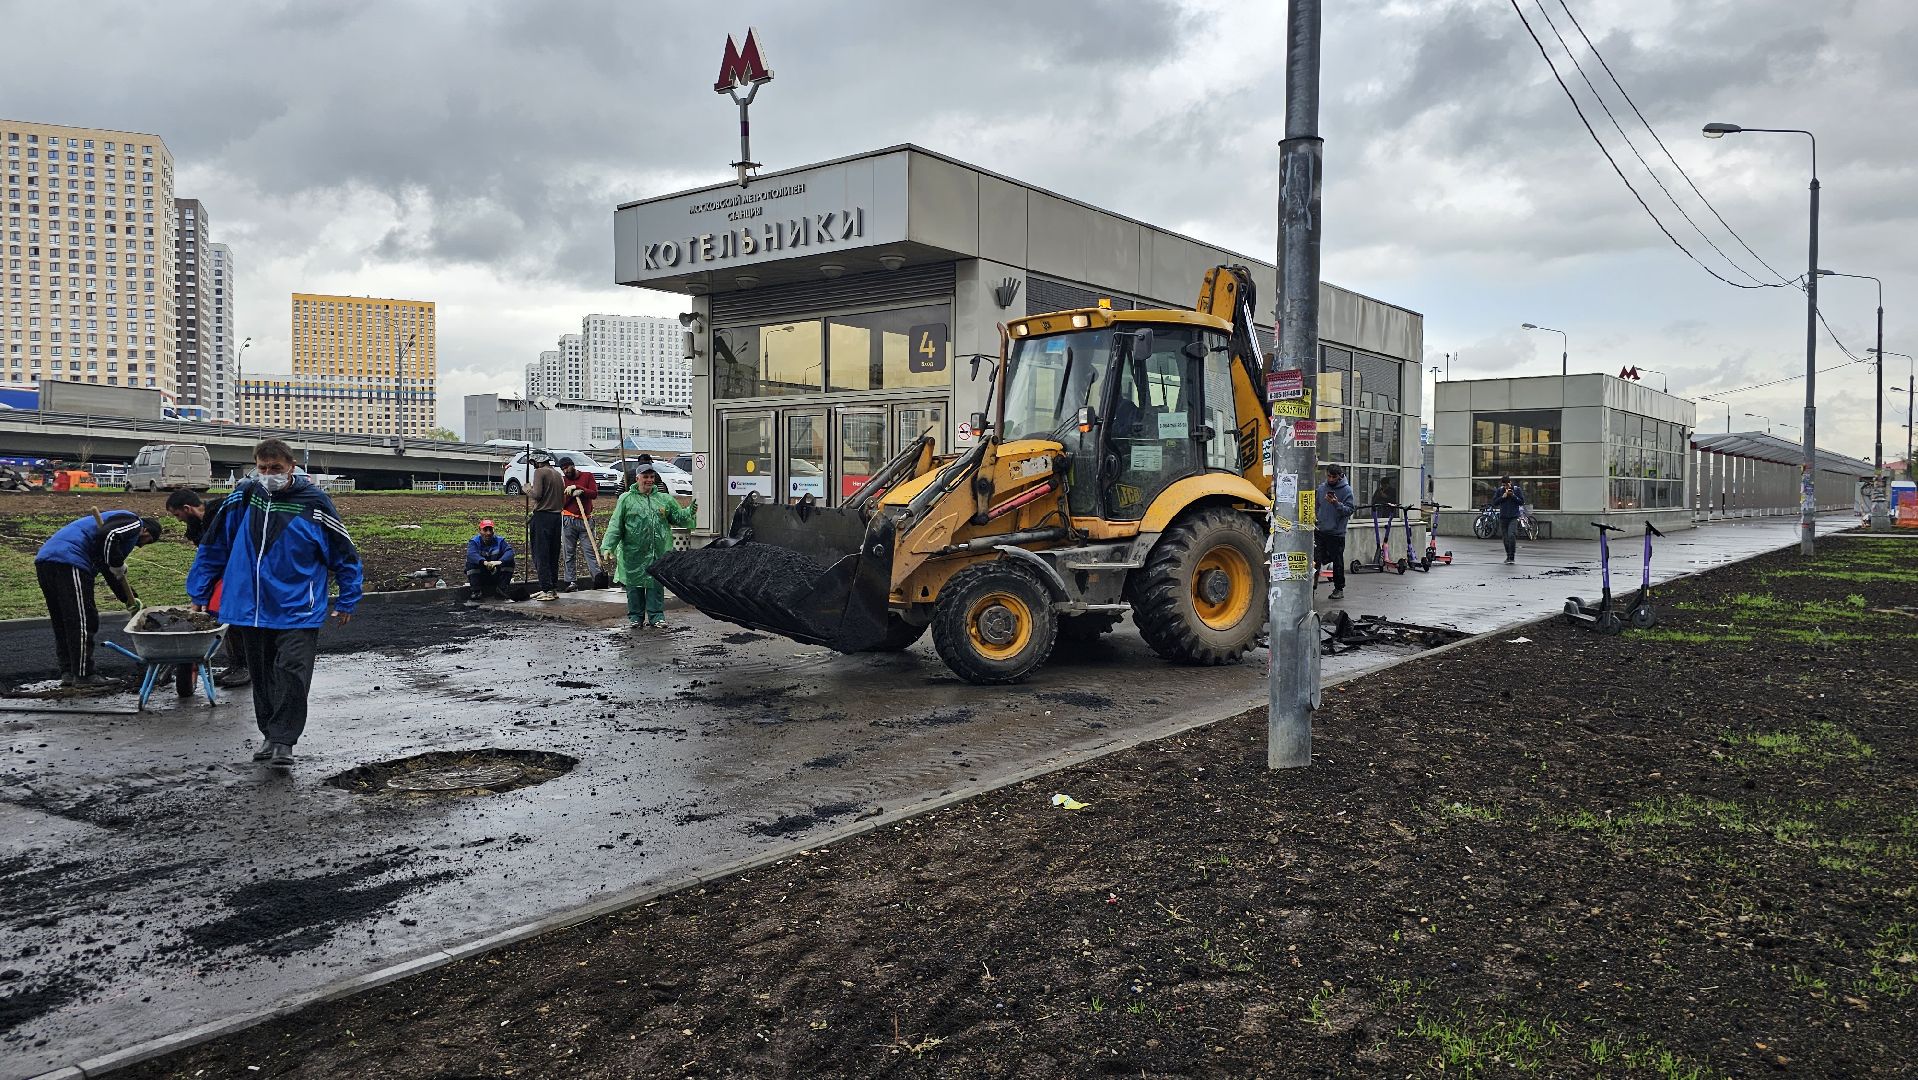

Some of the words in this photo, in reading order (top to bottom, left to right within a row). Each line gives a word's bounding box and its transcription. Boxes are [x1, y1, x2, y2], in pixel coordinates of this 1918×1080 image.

[714, 26, 774, 91] М
[689, 194, 742, 215] МОСКОВСКИЙ
[743, 184, 805, 205] МЕТРОПОЛИТЕН
[727, 206, 762, 222] СТАНЦИЯ
[643, 206, 863, 270] КОТЕЛЬНИКИ
[919, 331, 936, 359] 4
[1618, 364, 1641, 381] М
